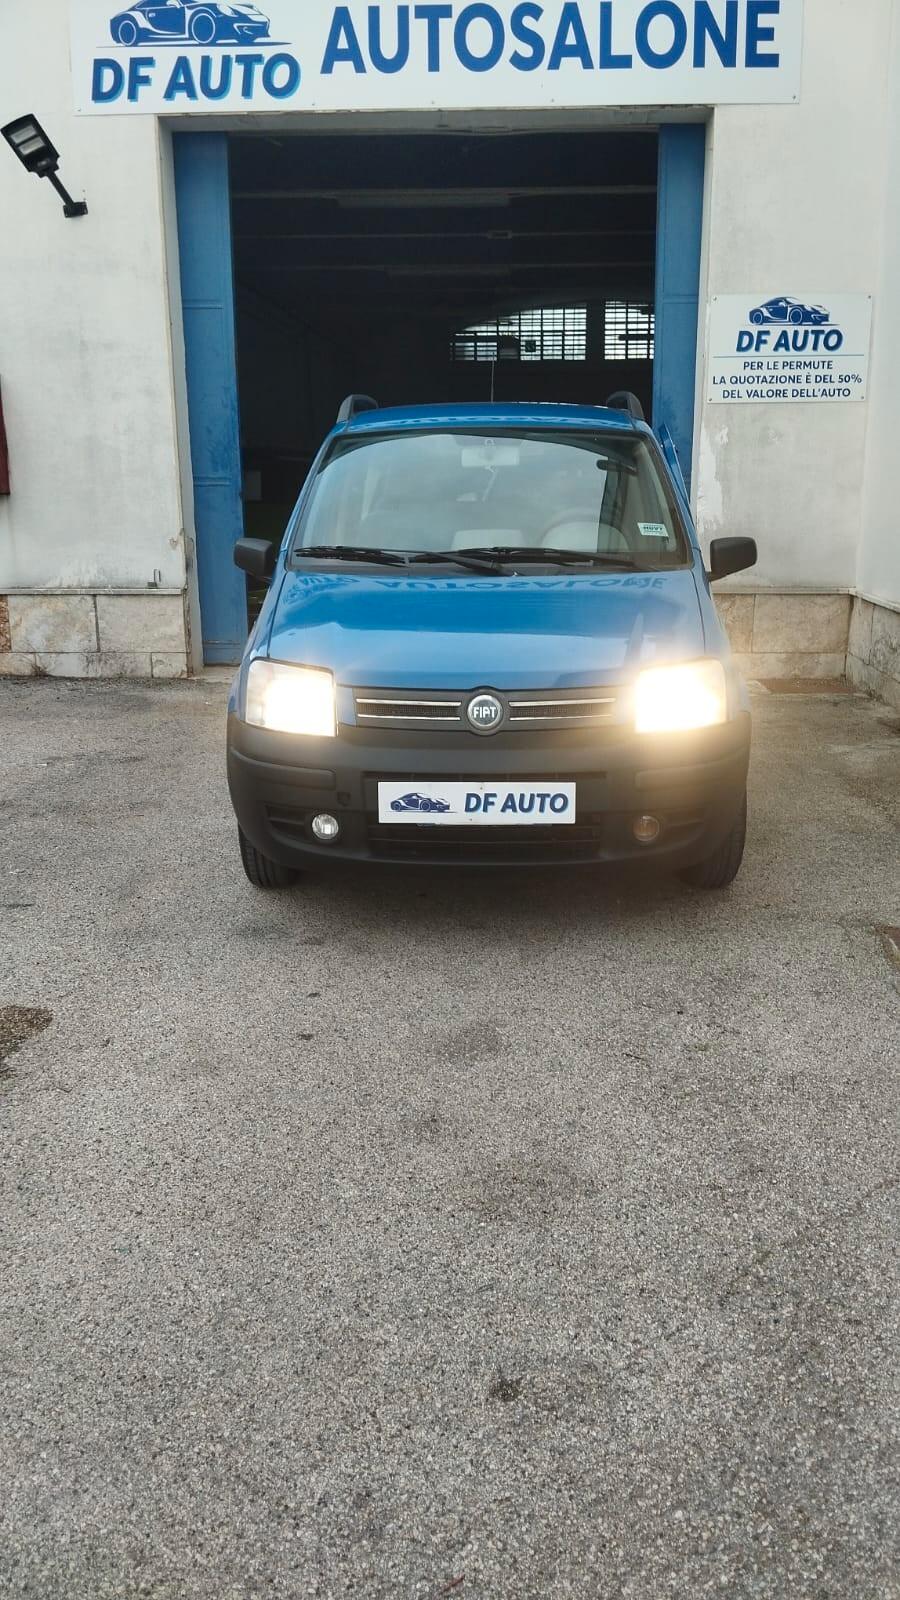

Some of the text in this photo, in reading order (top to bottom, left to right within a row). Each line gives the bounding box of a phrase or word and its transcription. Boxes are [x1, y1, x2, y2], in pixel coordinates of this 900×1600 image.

[320, 0, 780, 74] AUTOSALONE
[91, 53, 301, 103] DF AUTO
[736, 329, 843, 352] DF AUTO
[743, 360, 833, 370] PER LE PERMUTE
[712, 372, 862, 385] LA QUOTAZIONE È DEL 50%
[722, 388, 851, 398] DEL VALORE DELL'AUTO
[473, 706, 497, 718] FIAT
[464, 793, 569, 813] DF AUTO
